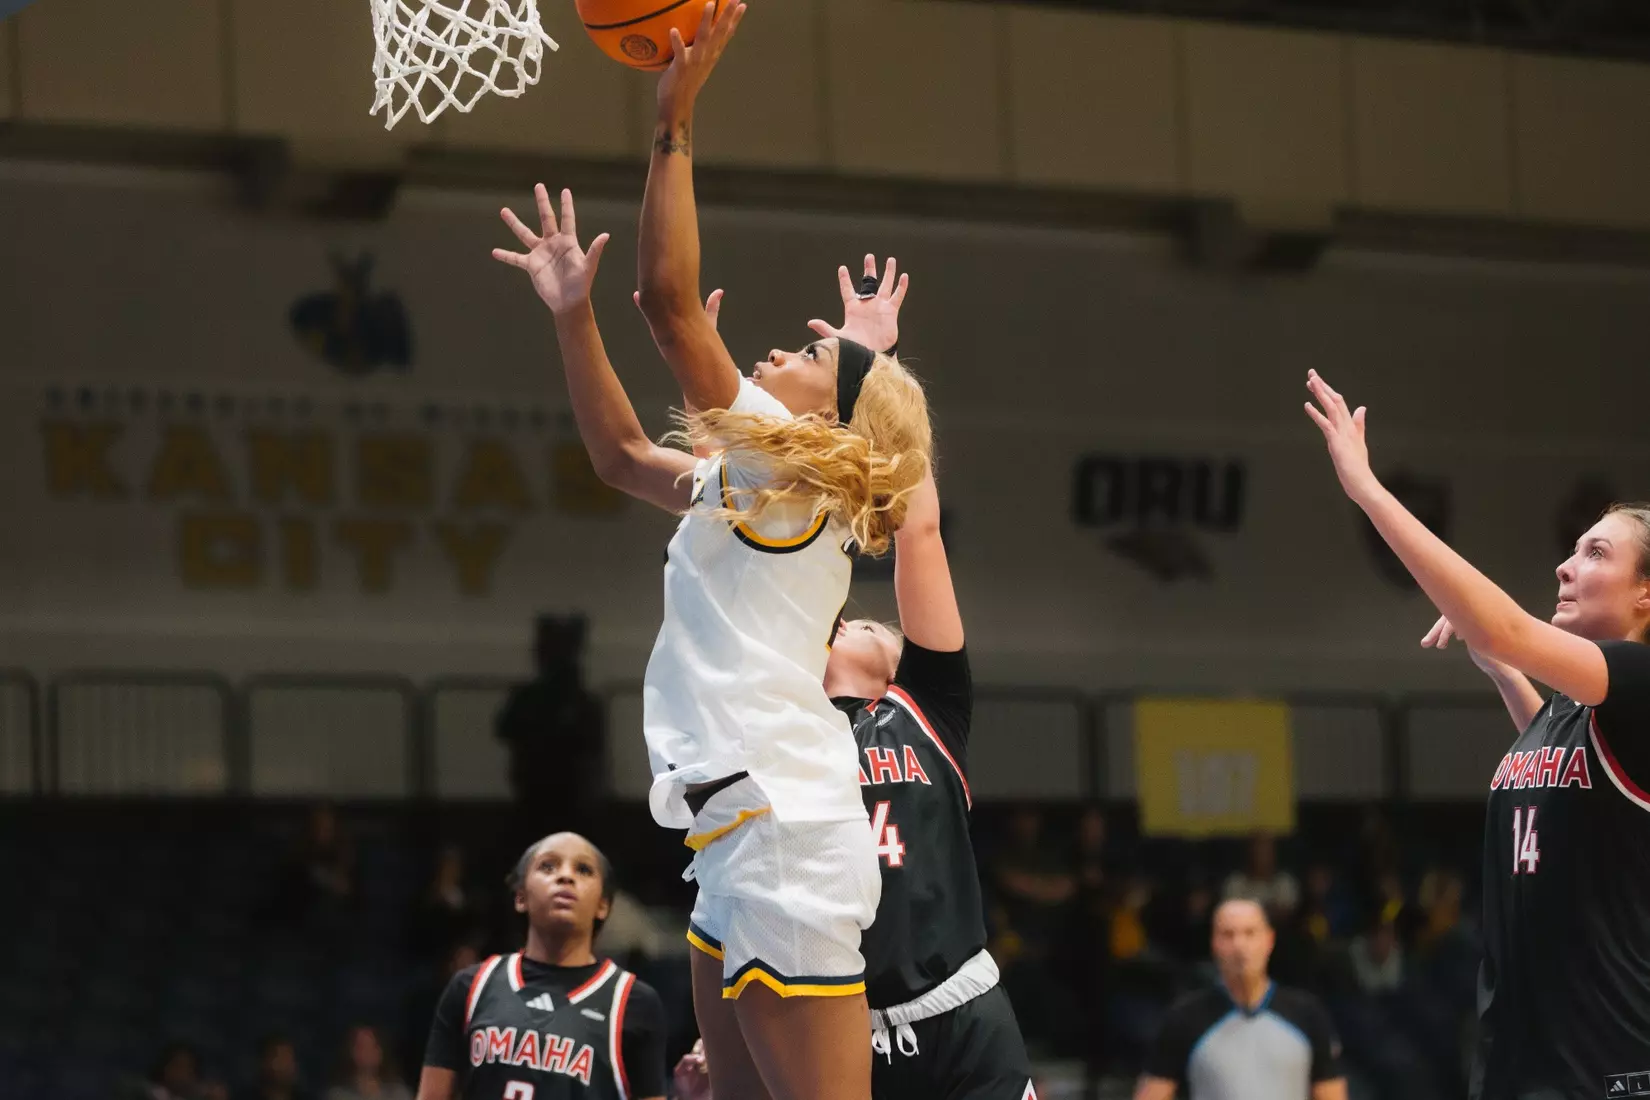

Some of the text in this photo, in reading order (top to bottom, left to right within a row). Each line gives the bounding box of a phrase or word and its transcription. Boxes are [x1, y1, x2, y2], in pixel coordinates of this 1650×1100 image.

[42, 418, 628, 518] KANSAS
[1071, 456, 1246, 533] ORU
[180, 513, 510, 595] CITY
[1490, 746, 1592, 790] OMAHA
[1513, 806, 1540, 874] 14
[470, 1026, 594, 1086] OMAHA
